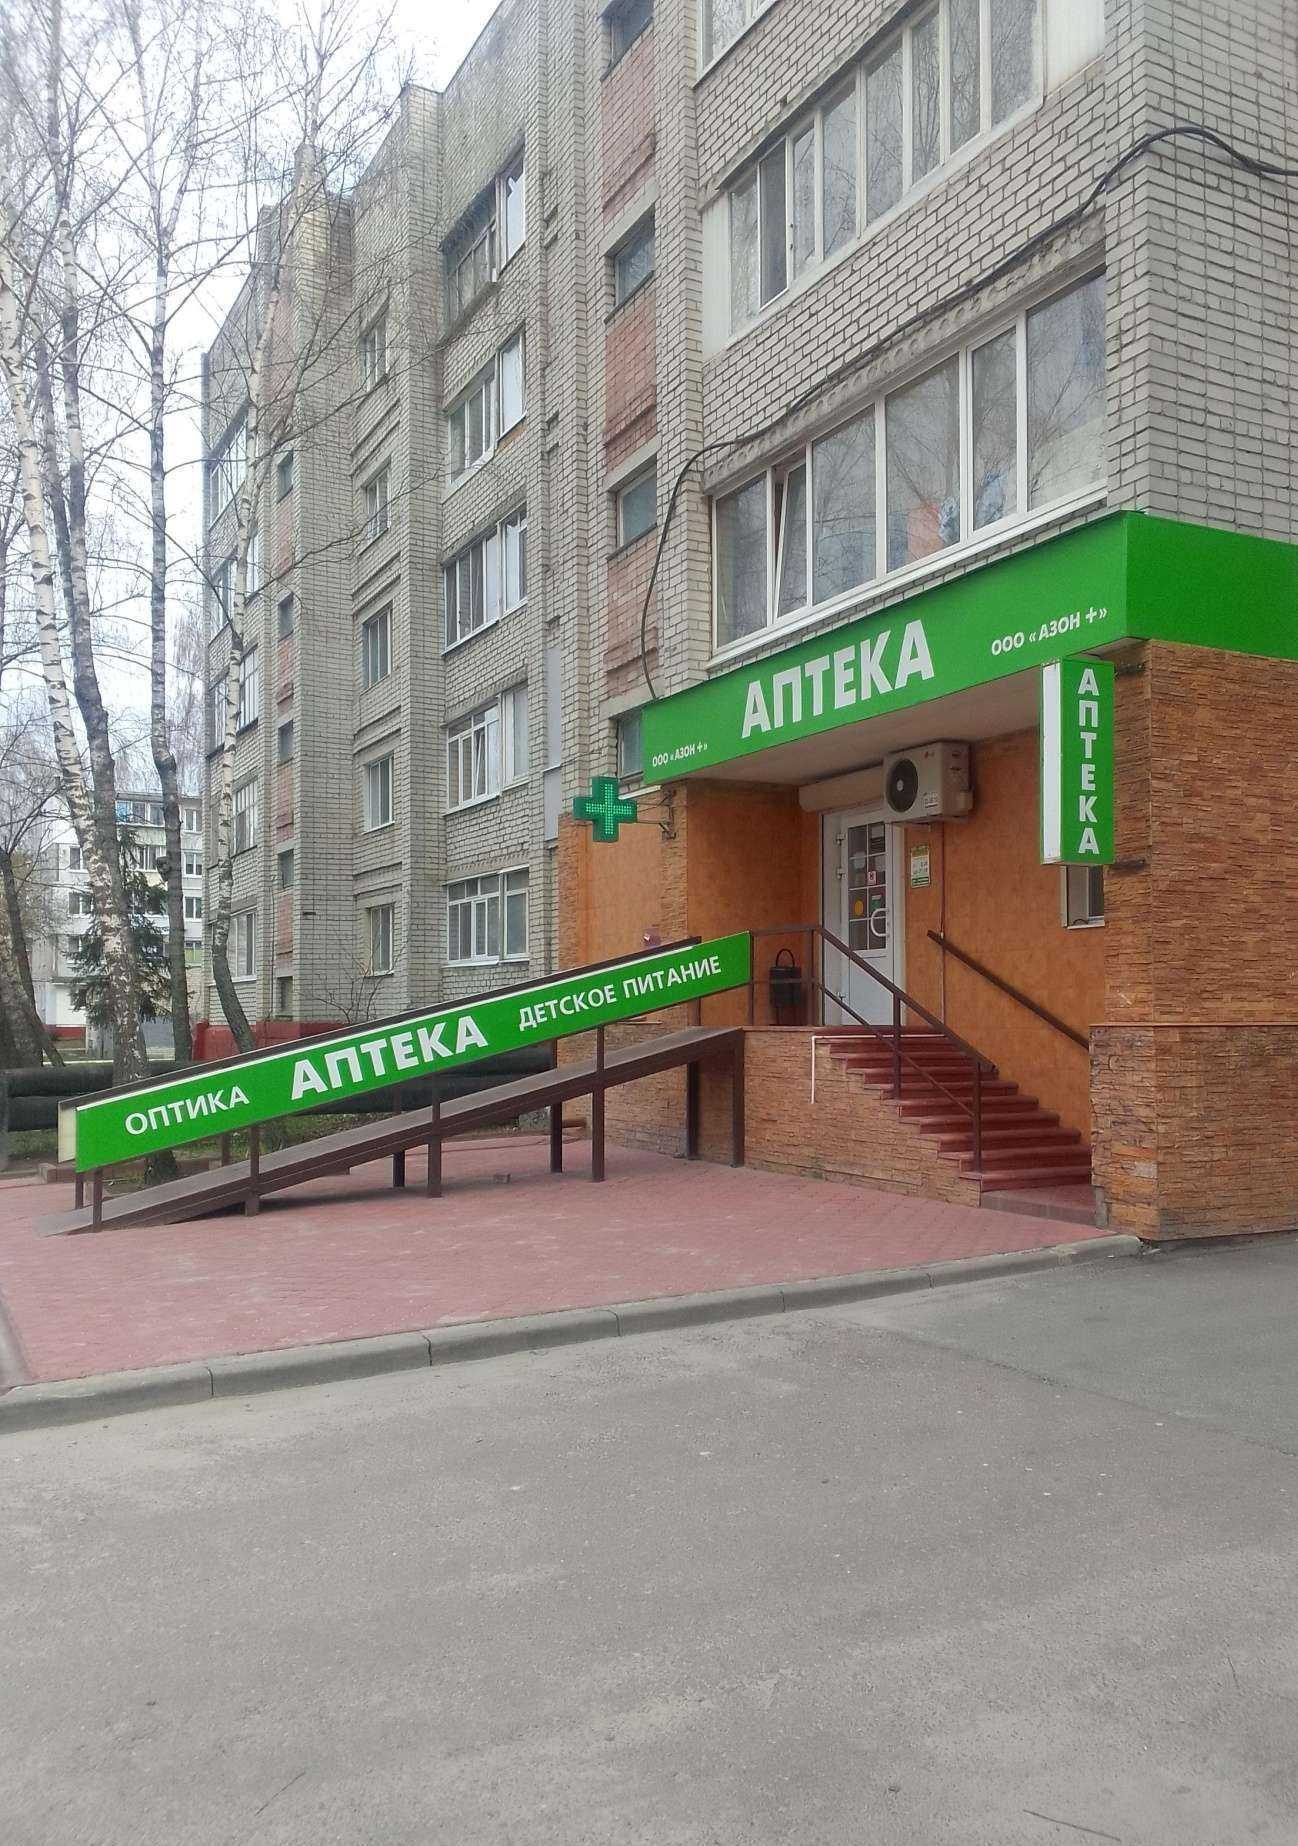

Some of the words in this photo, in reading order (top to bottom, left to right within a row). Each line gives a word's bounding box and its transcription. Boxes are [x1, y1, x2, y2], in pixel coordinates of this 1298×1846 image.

[742, 619, 935, 739] АПТЕКА
[991, 631, 1025, 656] ООО
[652, 752, 669, 768] ООО
[1078, 668, 1100, 855] АПТЕКА
[124, 1085, 250, 1136] ОПТИКА
[290, 1015, 489, 1101] АПТЕКА
[518, 983, 617, 1032] ДЕТСКОЕ
[623, 955, 722, 999] ПИТАНИЕ
